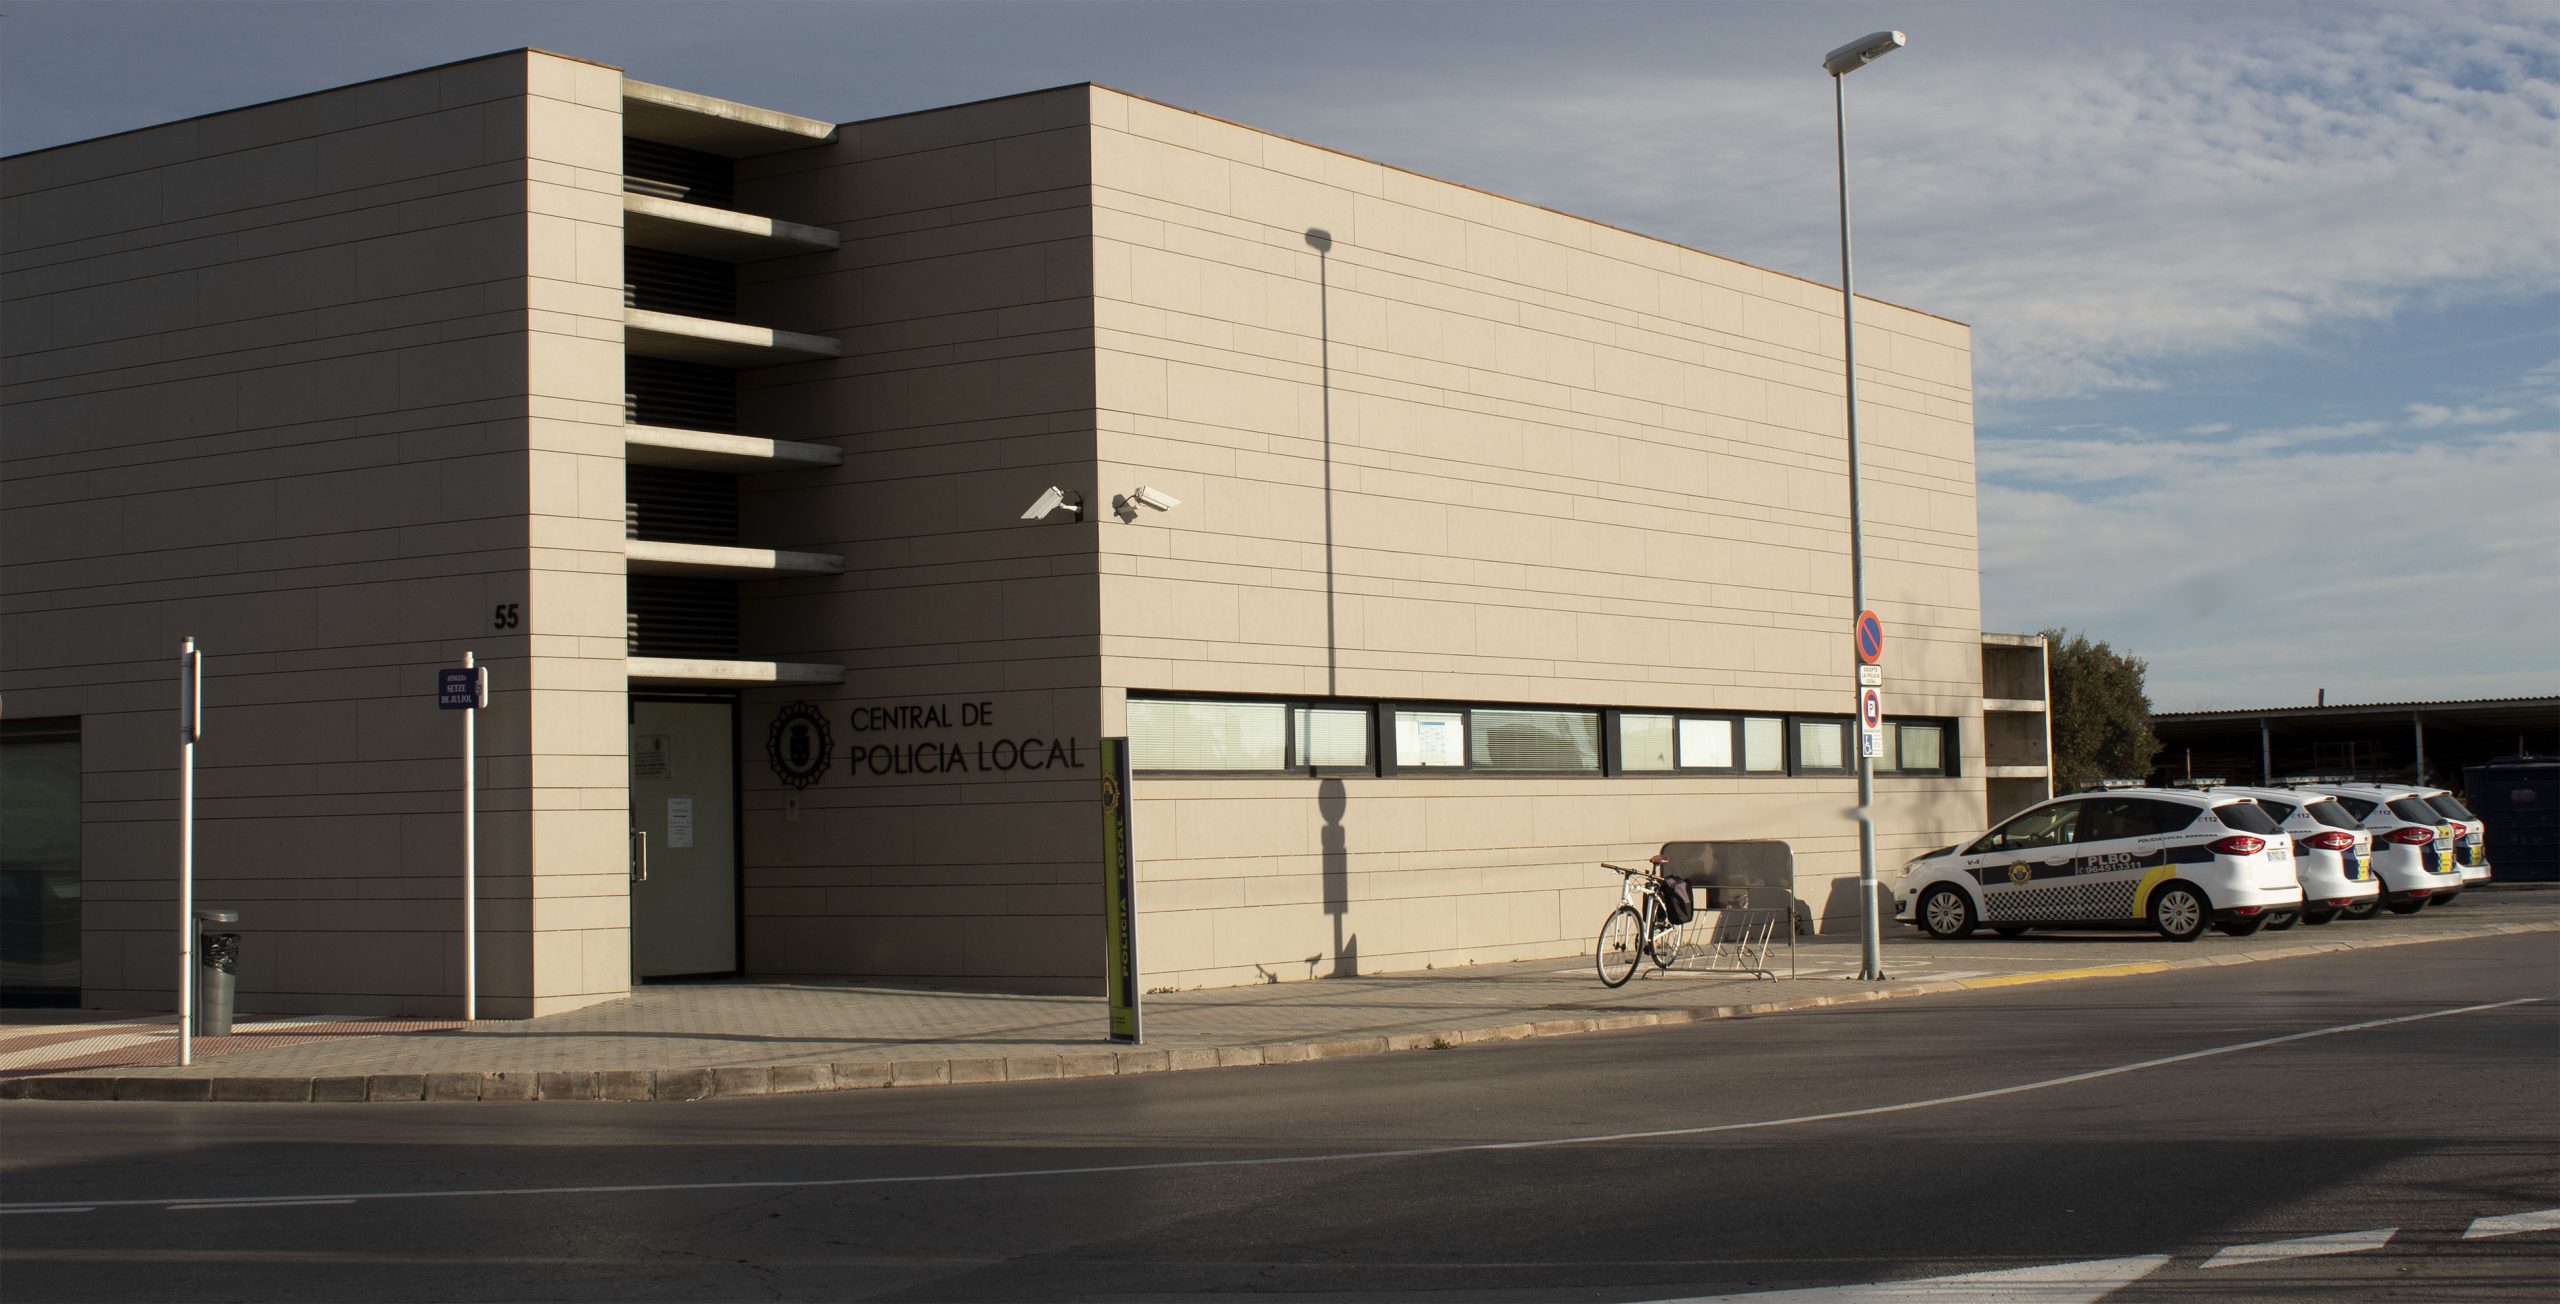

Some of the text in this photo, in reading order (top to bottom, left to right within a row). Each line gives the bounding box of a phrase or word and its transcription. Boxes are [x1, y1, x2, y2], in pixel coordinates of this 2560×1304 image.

[494, 603, 519, 629] 55
[447, 684, 467, 693] SETZE
[441, 695, 450, 703] DE
[851, 702, 992, 731] CENTRAL DE
[851, 737, 1084, 775] POLICIA LOCAL
[1118, 815, 1126, 880] LOCAL
[2086, 862, 2141, 873] 964513311
[2088, 853, 2131, 866] PLBO
